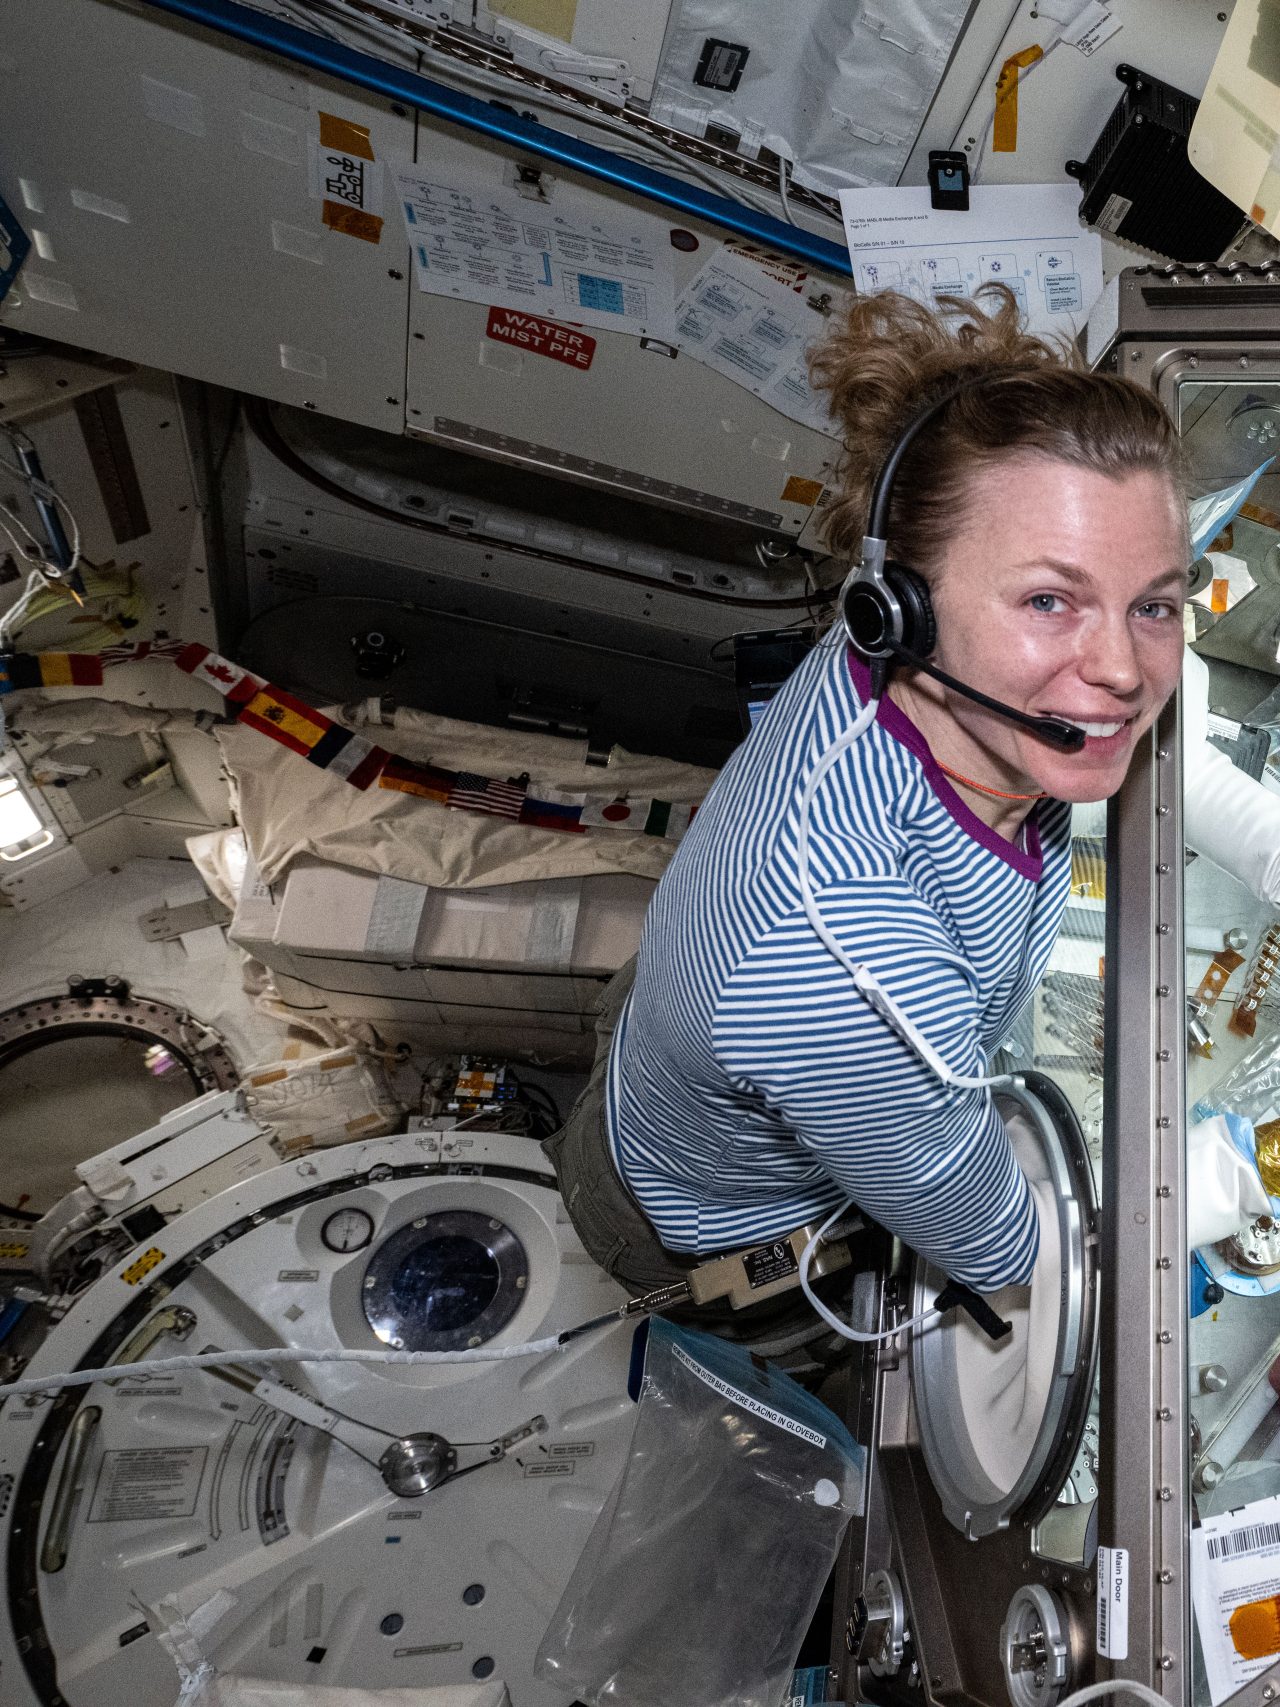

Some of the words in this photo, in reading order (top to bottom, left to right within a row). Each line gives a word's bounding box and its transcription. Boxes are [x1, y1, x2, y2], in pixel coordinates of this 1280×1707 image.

[731, 248, 781, 270] EMERGENCY
[780, 265, 797, 277] USE
[491, 322, 545, 348] MIST
[549, 341, 590, 365] PFE
[505, 311, 584, 348] WATER
[672, 1344, 686, 1362] REMOVE
[688, 1360, 702, 1375] FROM
[699, 1369, 716, 1385] OUTER
[713, 1379, 727, 1393] BAG
[724, 1386, 749, 1406] BEFORE
[747, 1400, 778, 1422] PLACING
[776, 1415, 786, 1426] IN
[784, 1419, 825, 1446] GLOVEBOX
[1114, 1577, 1122, 1602] Door
